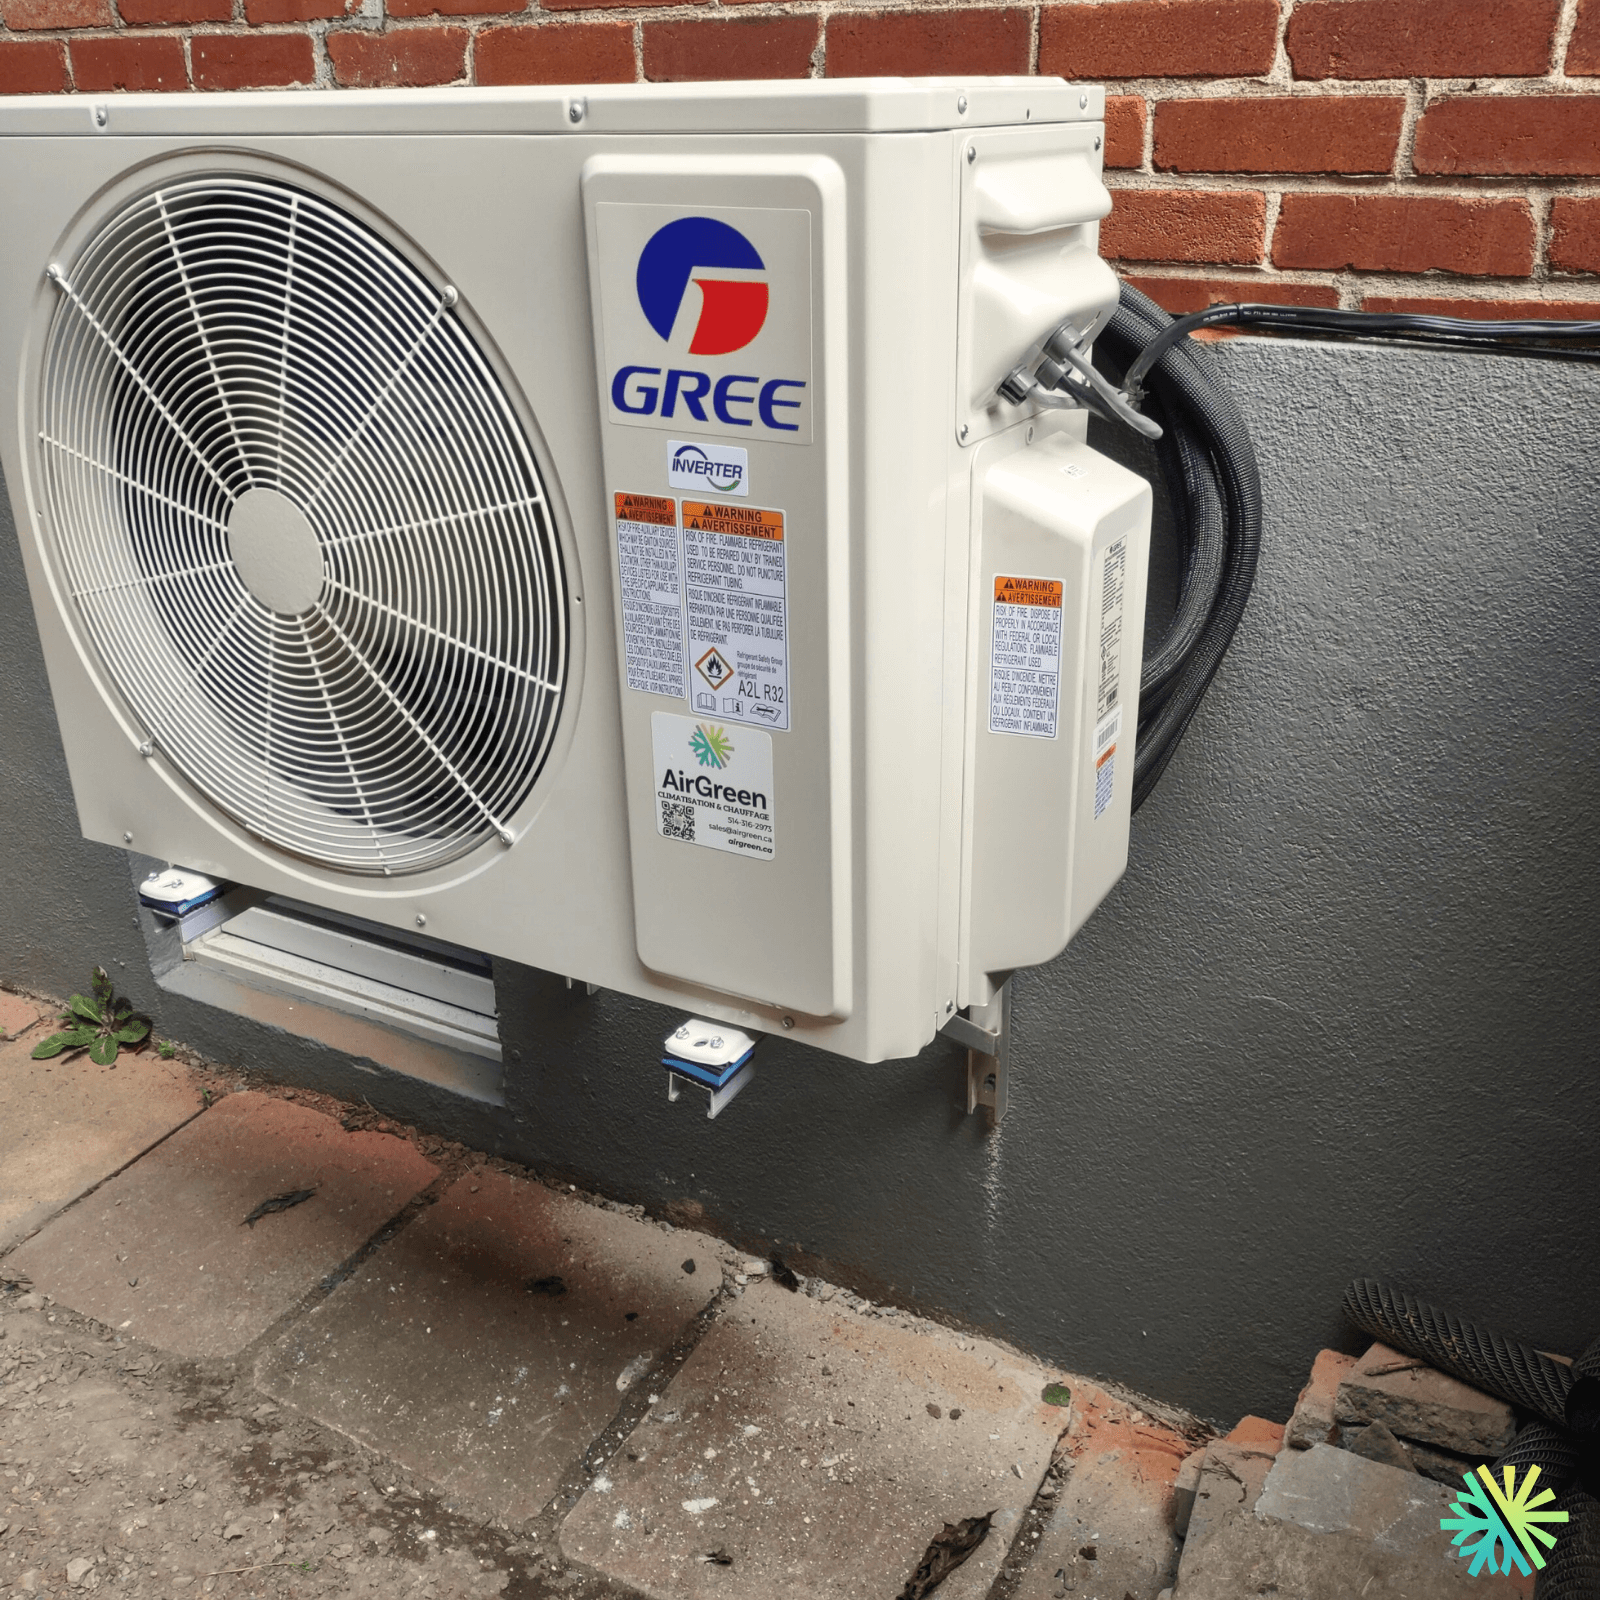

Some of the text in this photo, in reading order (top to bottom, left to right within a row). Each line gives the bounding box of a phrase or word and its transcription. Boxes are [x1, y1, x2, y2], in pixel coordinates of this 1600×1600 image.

[611, 365, 806, 431] GREE
[672, 458, 743, 479] INVERTER
[632, 496, 667, 510] WARNING
[628, 509, 674, 525] AVERTISSEMENT
[714, 506, 762, 523] WARNING
[701, 518, 776, 538] AVERTISSEMENT
[685, 530, 696, 542] RISK
[697, 531, 704, 543] OF
[719, 534, 747, 548] FLAMMABLE
[748, 538, 782, 553] REFRIGERANT
[644, 546, 664, 559] INSTALLED
[701, 545, 708, 557] TO
[709, 546, 715, 558] BE
[716, 547, 739, 561] REPAIRED
[740, 551, 753, 563] ONLY
[754, 553, 761, 564] BY
[762, 554, 782, 567] TRAINED
[621, 565, 637, 576] DEVICES
[637, 567, 650, 578] LISTED
[686, 557, 706, 570] SERVICE
[737, 564, 745, 576] DO
[746, 565, 756, 577] NOT
[757, 567, 783, 581] PUNCTURE
[687, 570, 722, 586] REFRIGERANT
[1014, 579, 1054, 592] WARNING
[688, 587, 702, 600] RISQUE
[1008, 591, 1060, 606] AVERTISSEMENT
[716, 606, 724, 617] PAR
[725, 607, 735, 619] UNE
[735, 609, 759, 623] PERSONNE
[996, 604, 1006, 616] RISK
[1008, 606, 1015, 616] OF
[1030, 608, 1050, 620] DISPOSE
[1052, 610, 1058, 620] OF
[715, 619, 721, 630] NE
[722, 620, 730, 632] PAS
[731, 622, 753, 636] PERFORER
[754, 626, 760, 637] LA
[761, 627, 783, 641] TUBULURE
[995, 616, 1058, 632] PROPERLY IN ACCORDANCE
[690, 628, 696, 640] DE
[995, 629, 1057, 645] WITH FEDERAL OR LOCAL
[1029, 643, 1057, 656] FLAMMABLE
[758, 654, 770, 665] Safety
[770, 656, 782, 667] Group
[994, 652, 1026, 666] REFRIGERANT
[993, 669, 1010, 680] RISQUE
[1038, 673, 1056, 685] METTRE
[737, 678, 783, 703] A2L R32
[993, 681, 1000, 691] AU
[1001, 682, 1016, 693] REBUT
[993, 693, 1001, 703] AUX
[992, 705, 999, 715] OU
[1022, 708, 1045, 720] CONTIENT
[1047, 710, 1054, 721] UN
[662, 769, 766, 810] AirGreen
[658, 791, 715, 808] CLIMATISATION
[723, 805, 770, 820] CHAUFFAGE
[728, 816, 772, 832] 514-316-2973
[708, 823, 772, 843] sales@airgreen.ca
[728, 838, 772, 854] airgreen.ca
